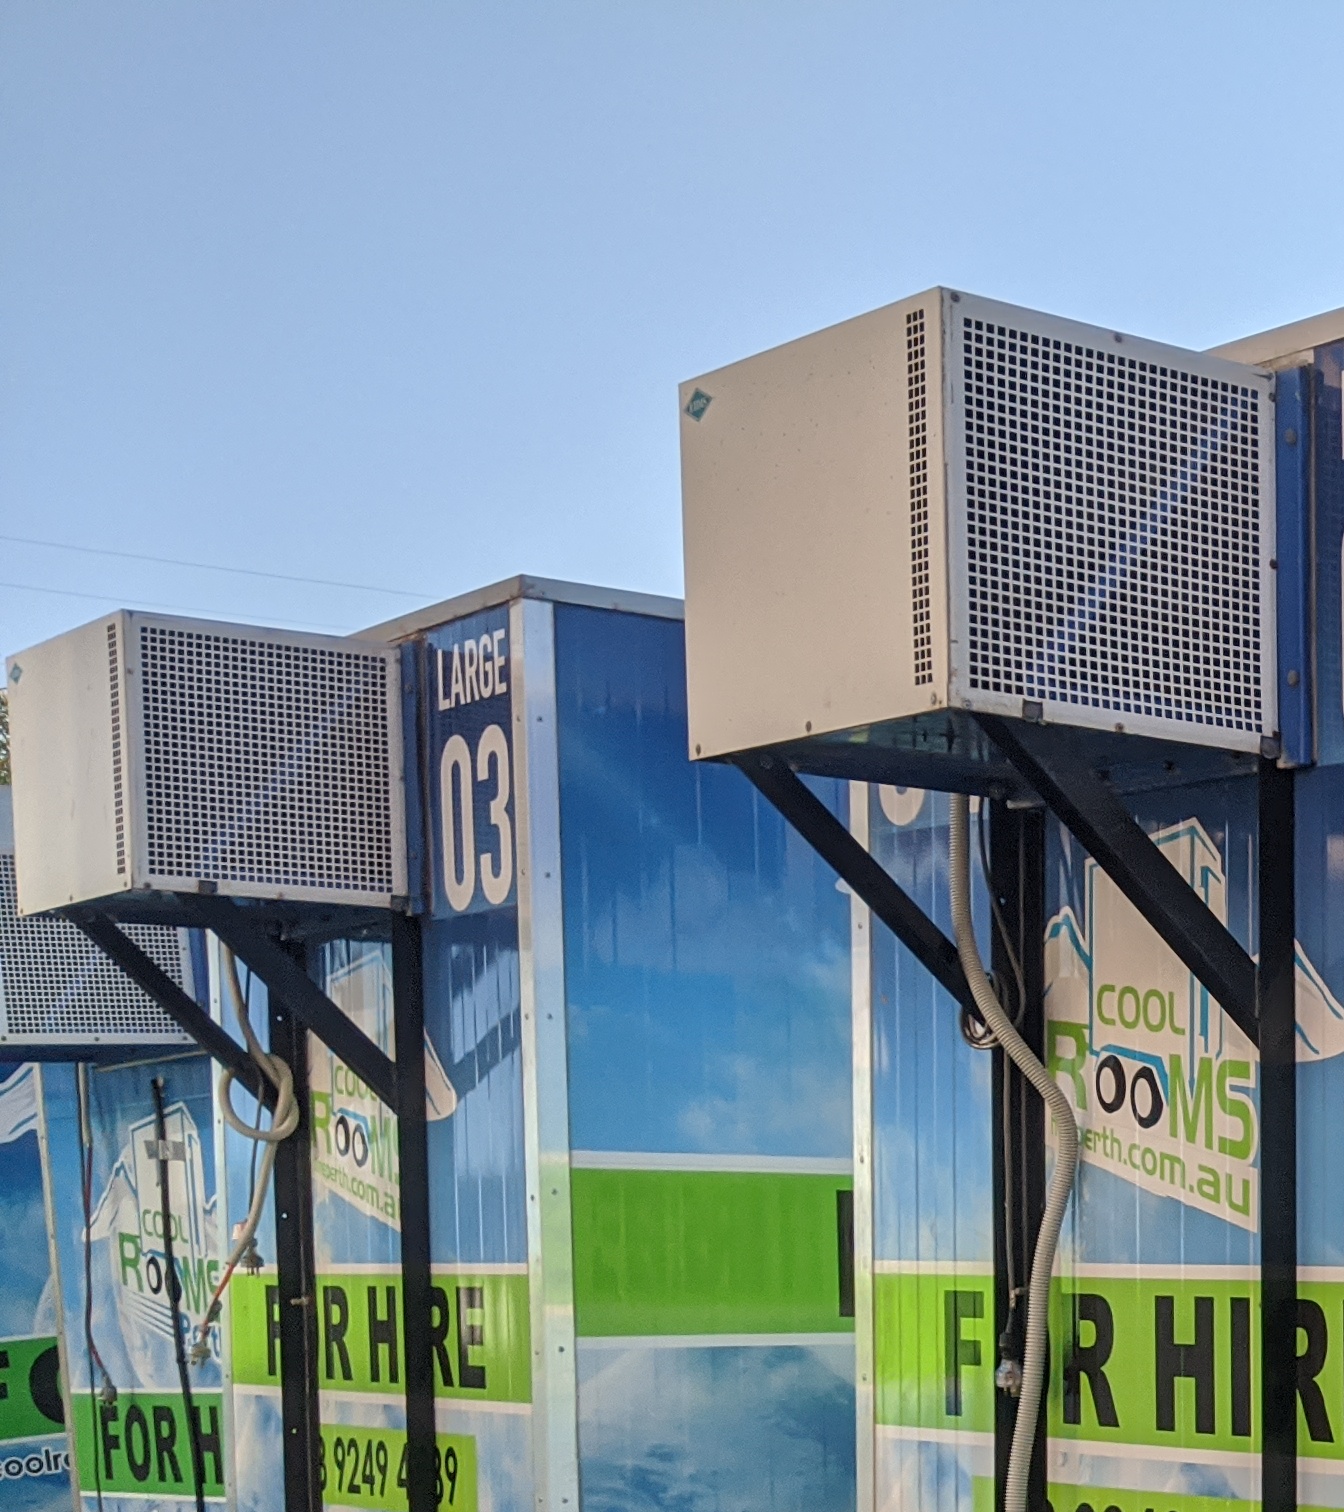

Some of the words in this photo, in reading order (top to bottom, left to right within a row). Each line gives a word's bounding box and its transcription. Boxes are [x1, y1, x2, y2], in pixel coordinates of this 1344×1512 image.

[437, 628, 507, 711] LARGE
[440, 724, 512, 912] 03
[1097, 984, 1186, 1036] COOL
[335, 1065, 379, 1102] COO
[1047, 1019, 1254, 1160] ROOMS
[311, 1091, 399, 1186] ROOM
[266, 1285, 353, 1381] FR
[367, 1286, 487, 1389] HRE
[944, 1290, 1120, 1428] FR
[100, 1403, 183, 1483] FOR
[333, 1437, 388, 1498] 9249
[397, 1442, 457, 1506] 49
